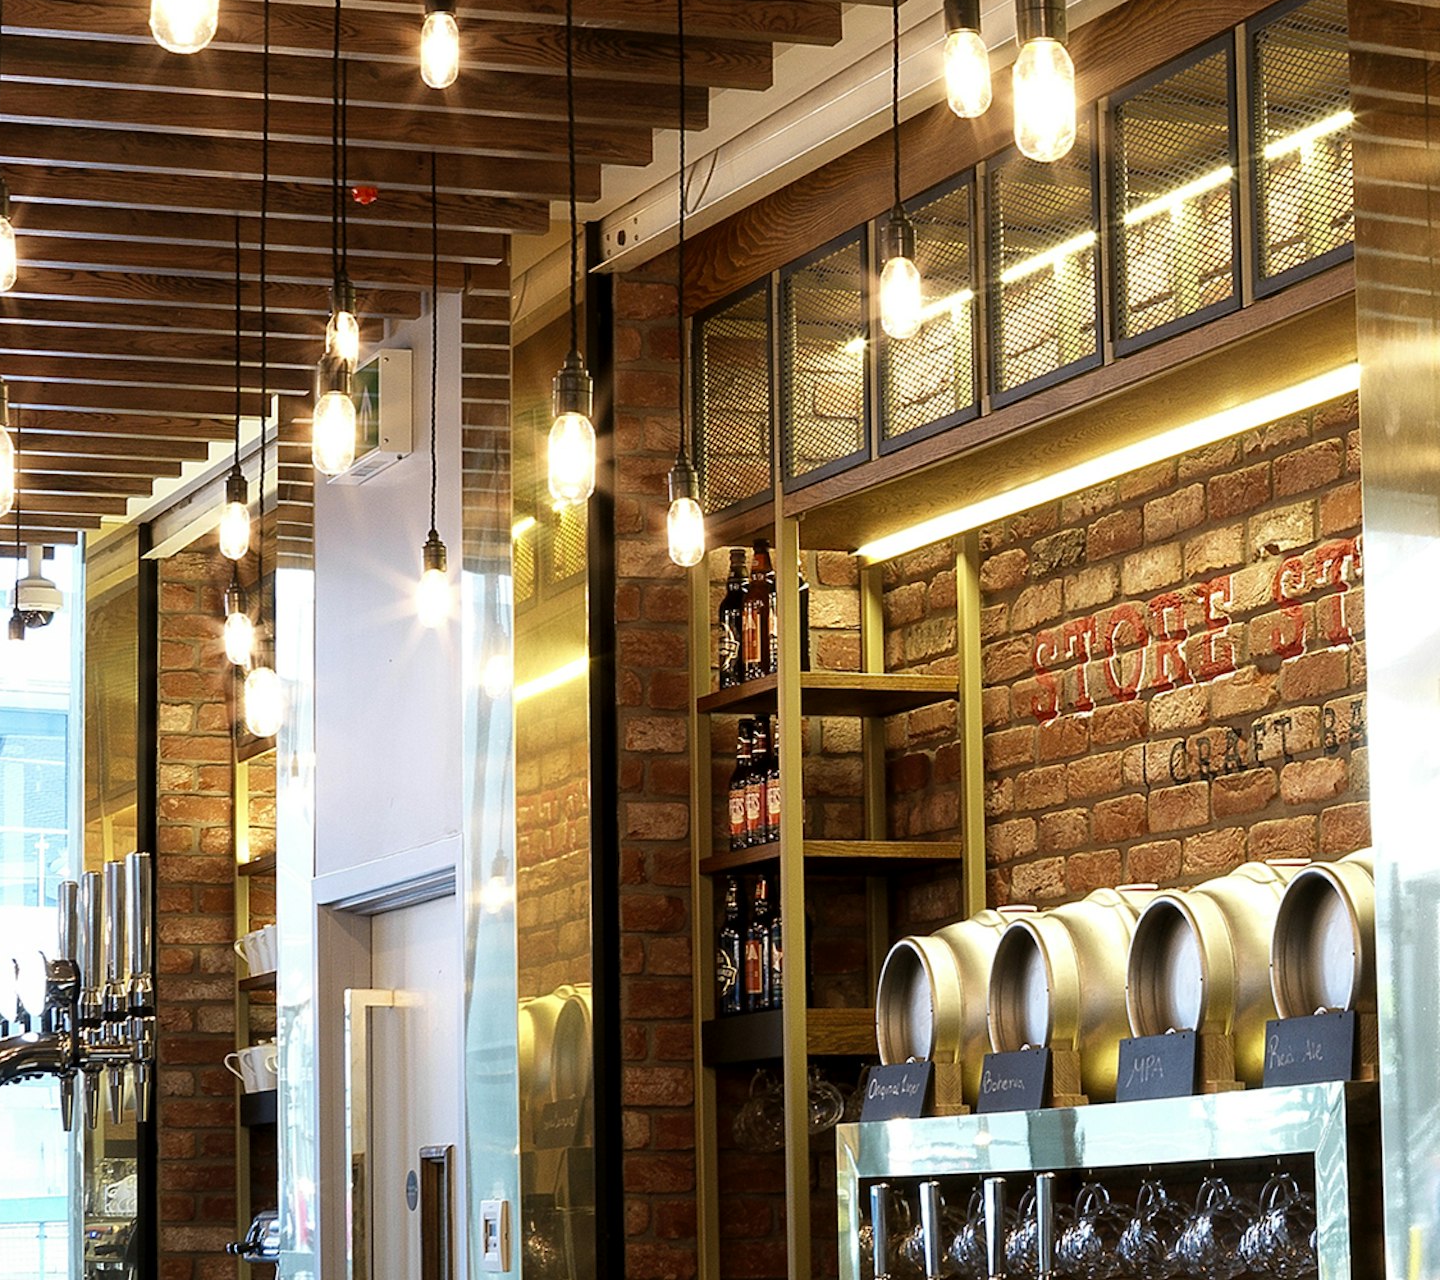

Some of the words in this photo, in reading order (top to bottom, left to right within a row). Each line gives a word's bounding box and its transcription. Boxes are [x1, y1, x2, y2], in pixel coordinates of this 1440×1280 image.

[1032, 574, 1239, 728] STORE
[1272, 533, 1363, 658] ST
[1169, 716, 1292, 784] CRAFT
[1322, 700, 1365, 757] BA
[1126, 1055, 1165, 1088] MPA
